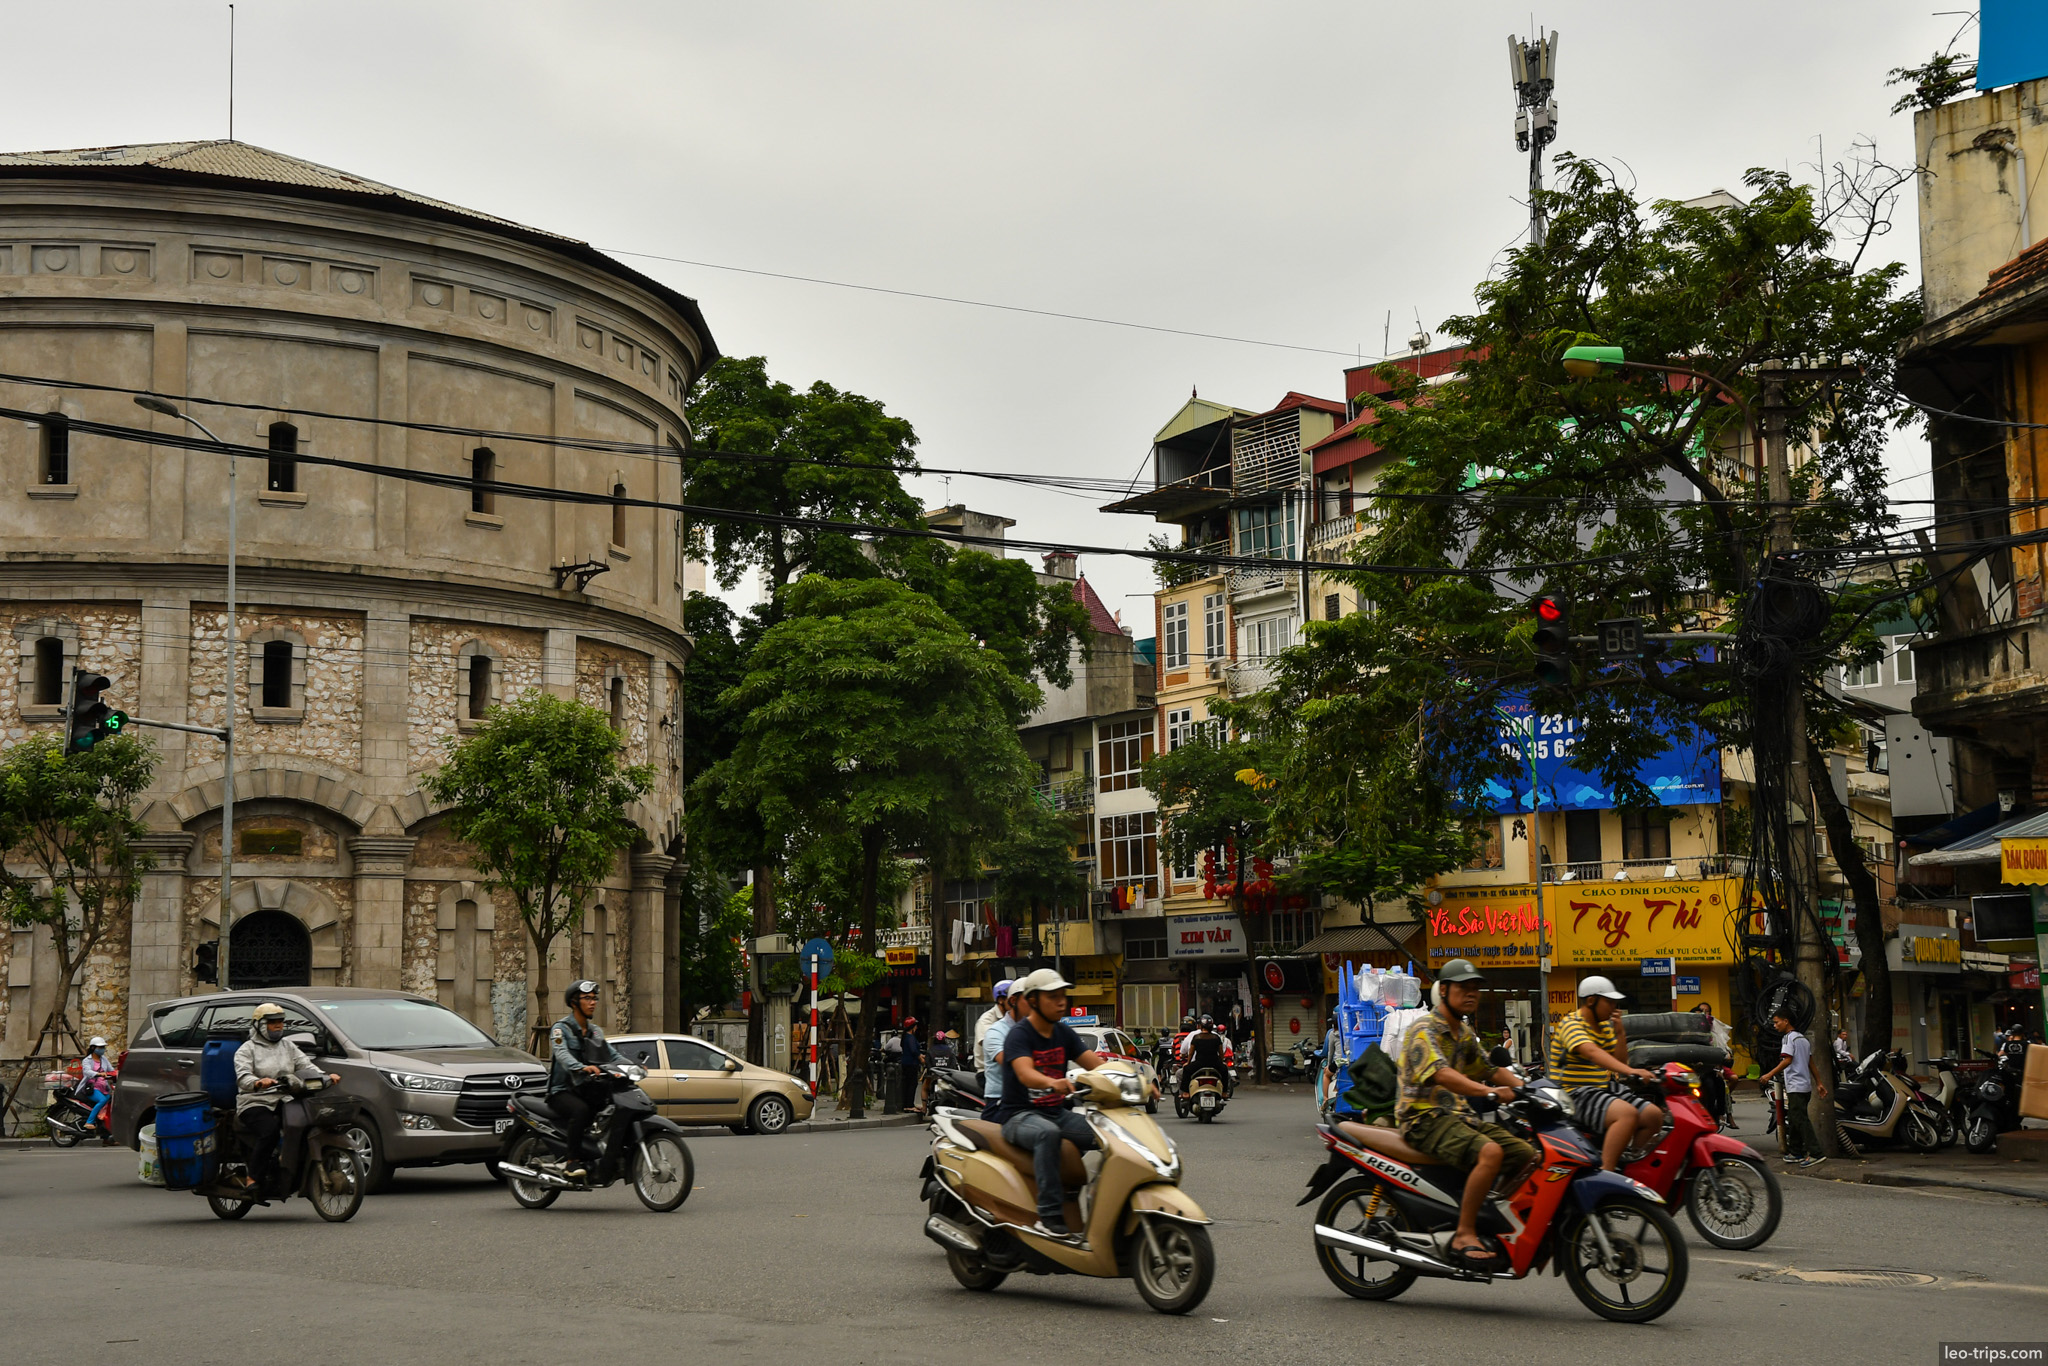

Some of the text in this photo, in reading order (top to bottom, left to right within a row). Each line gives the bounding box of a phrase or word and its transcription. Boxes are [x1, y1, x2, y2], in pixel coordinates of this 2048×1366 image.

[2005, 845, 2048, 870] BÁN BUÔN
[1582, 888, 1616, 897] CHÁO
[1620, 887, 1649, 895] DINH
[1457, 906, 1485, 936] Sào
[1485, 905, 1517, 936] Việt
[1569, 899, 1632, 948] Tây
[1643, 897, 1702, 933] Thi
[1180, 926, 1232, 944] KIM VÂN
[1430, 945, 1443, 957] NHÀ
[1445, 947, 1461, 957] KHAI
[1463, 945, 1480, 956] THÁC
[1483, 945, 1500, 958] TRỰC
[1503, 942, 1518, 956] TIẾP
[1520, 942, 1533, 955] SẢN
[1915, 936, 1940, 964] QUANG
[887, 967, 922, 977] ASHION
[1548, 991, 1575, 1003] IETNEST
[1367, 1157, 1420, 1187] REPSOL
